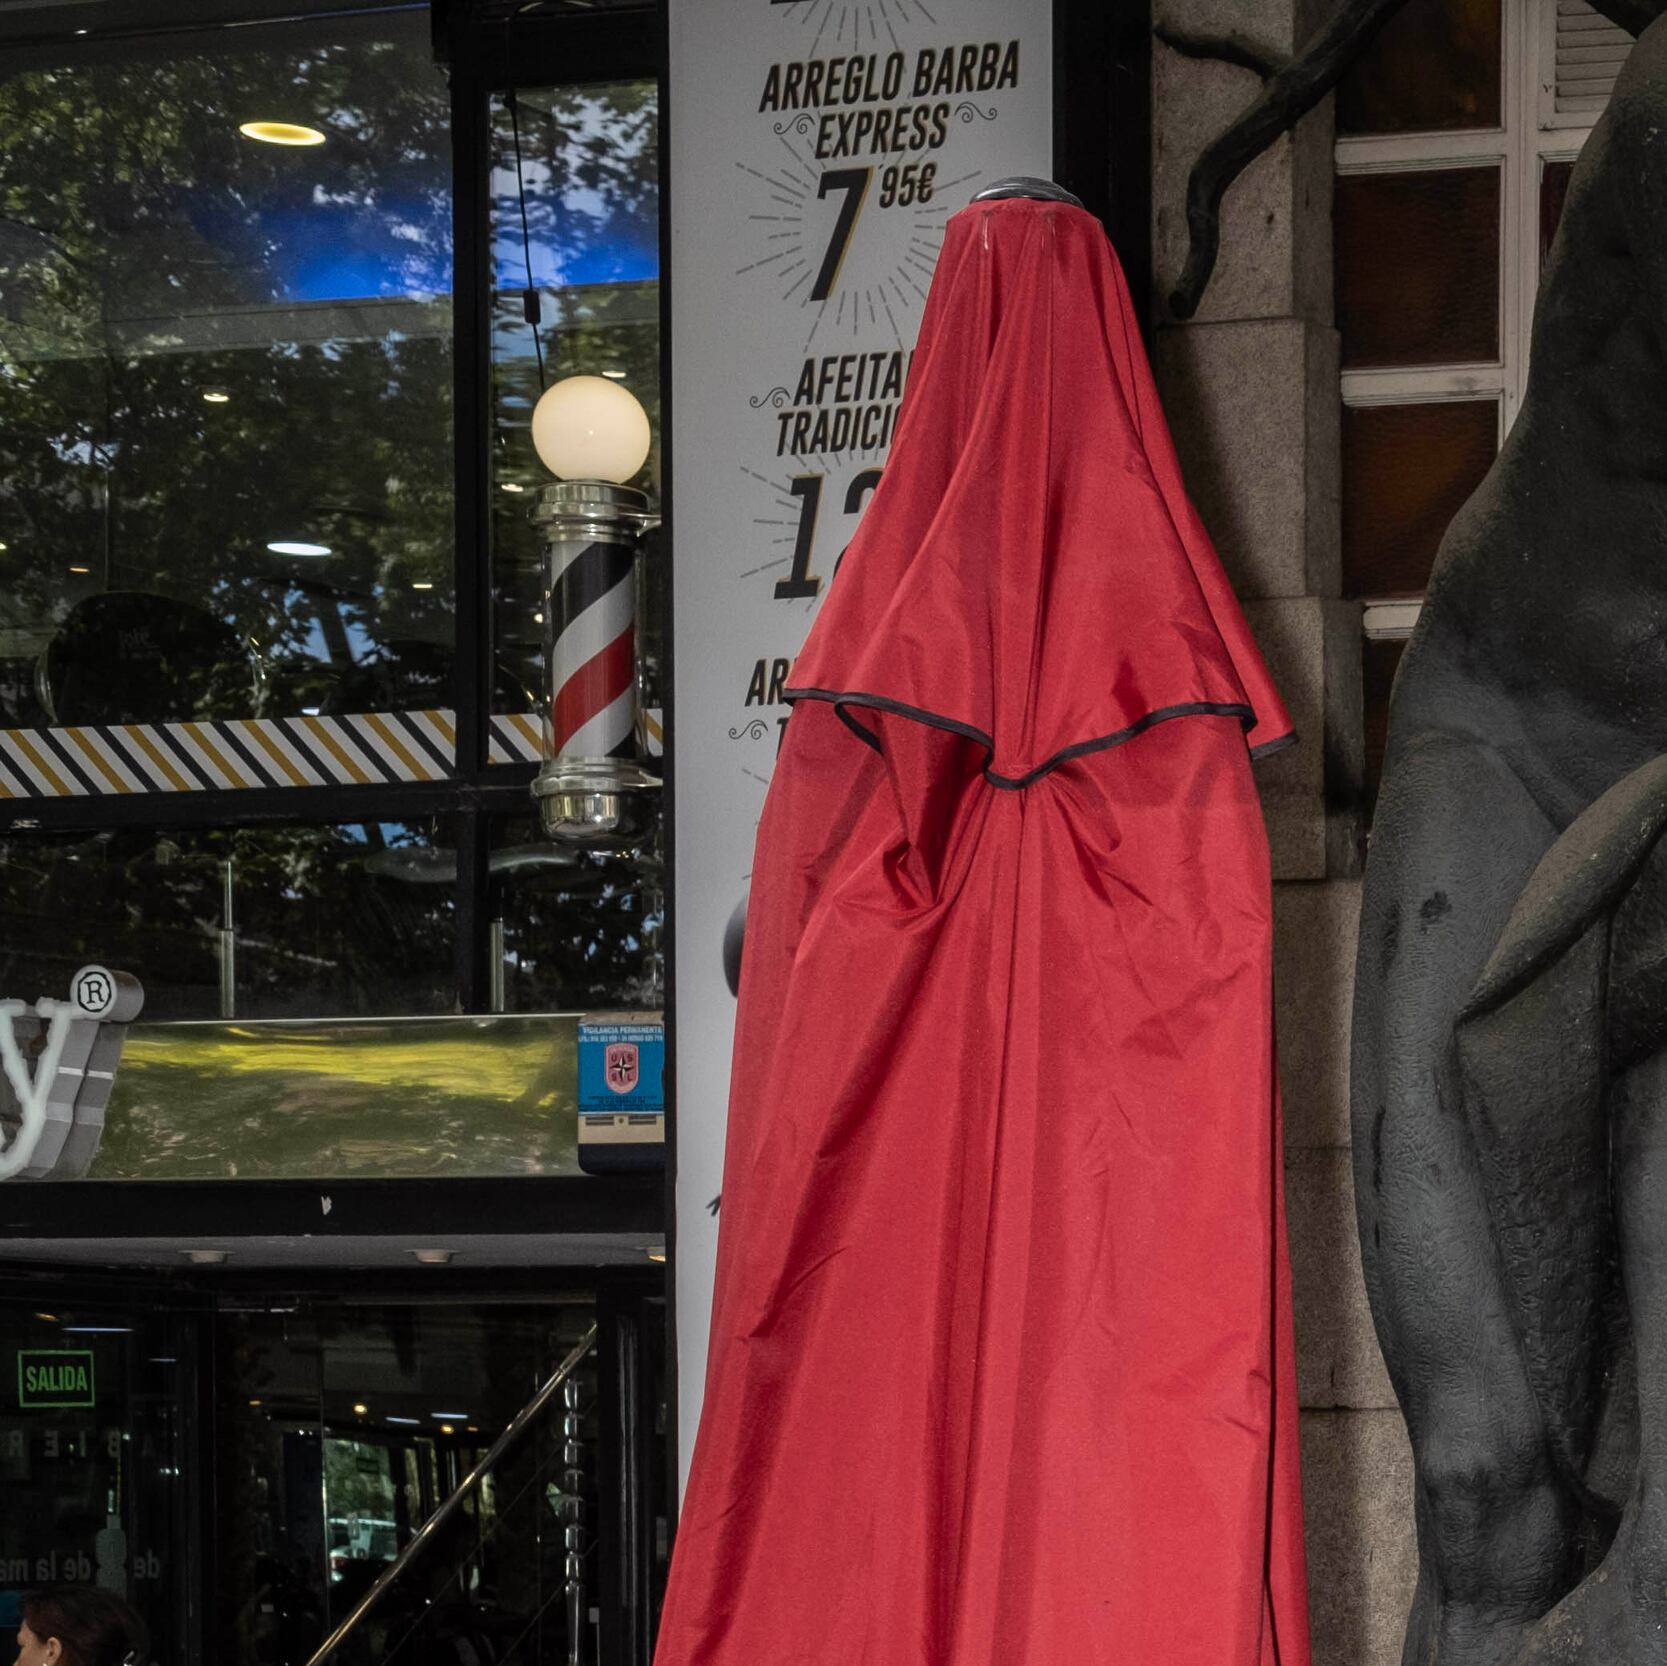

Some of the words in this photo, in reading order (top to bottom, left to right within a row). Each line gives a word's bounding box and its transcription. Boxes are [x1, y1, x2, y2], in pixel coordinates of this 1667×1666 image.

[759, 51, 905, 113] ARREGLO
[912, 38, 1020, 99] BARBA
[814, 102, 951, 160] EXPRESS
[809, 166, 875, 301] 7
[793, 350, 916, 407] AFEITA
[745, 657, 796, 707] AR
[26, 1365, 88, 1393] SALIDA
